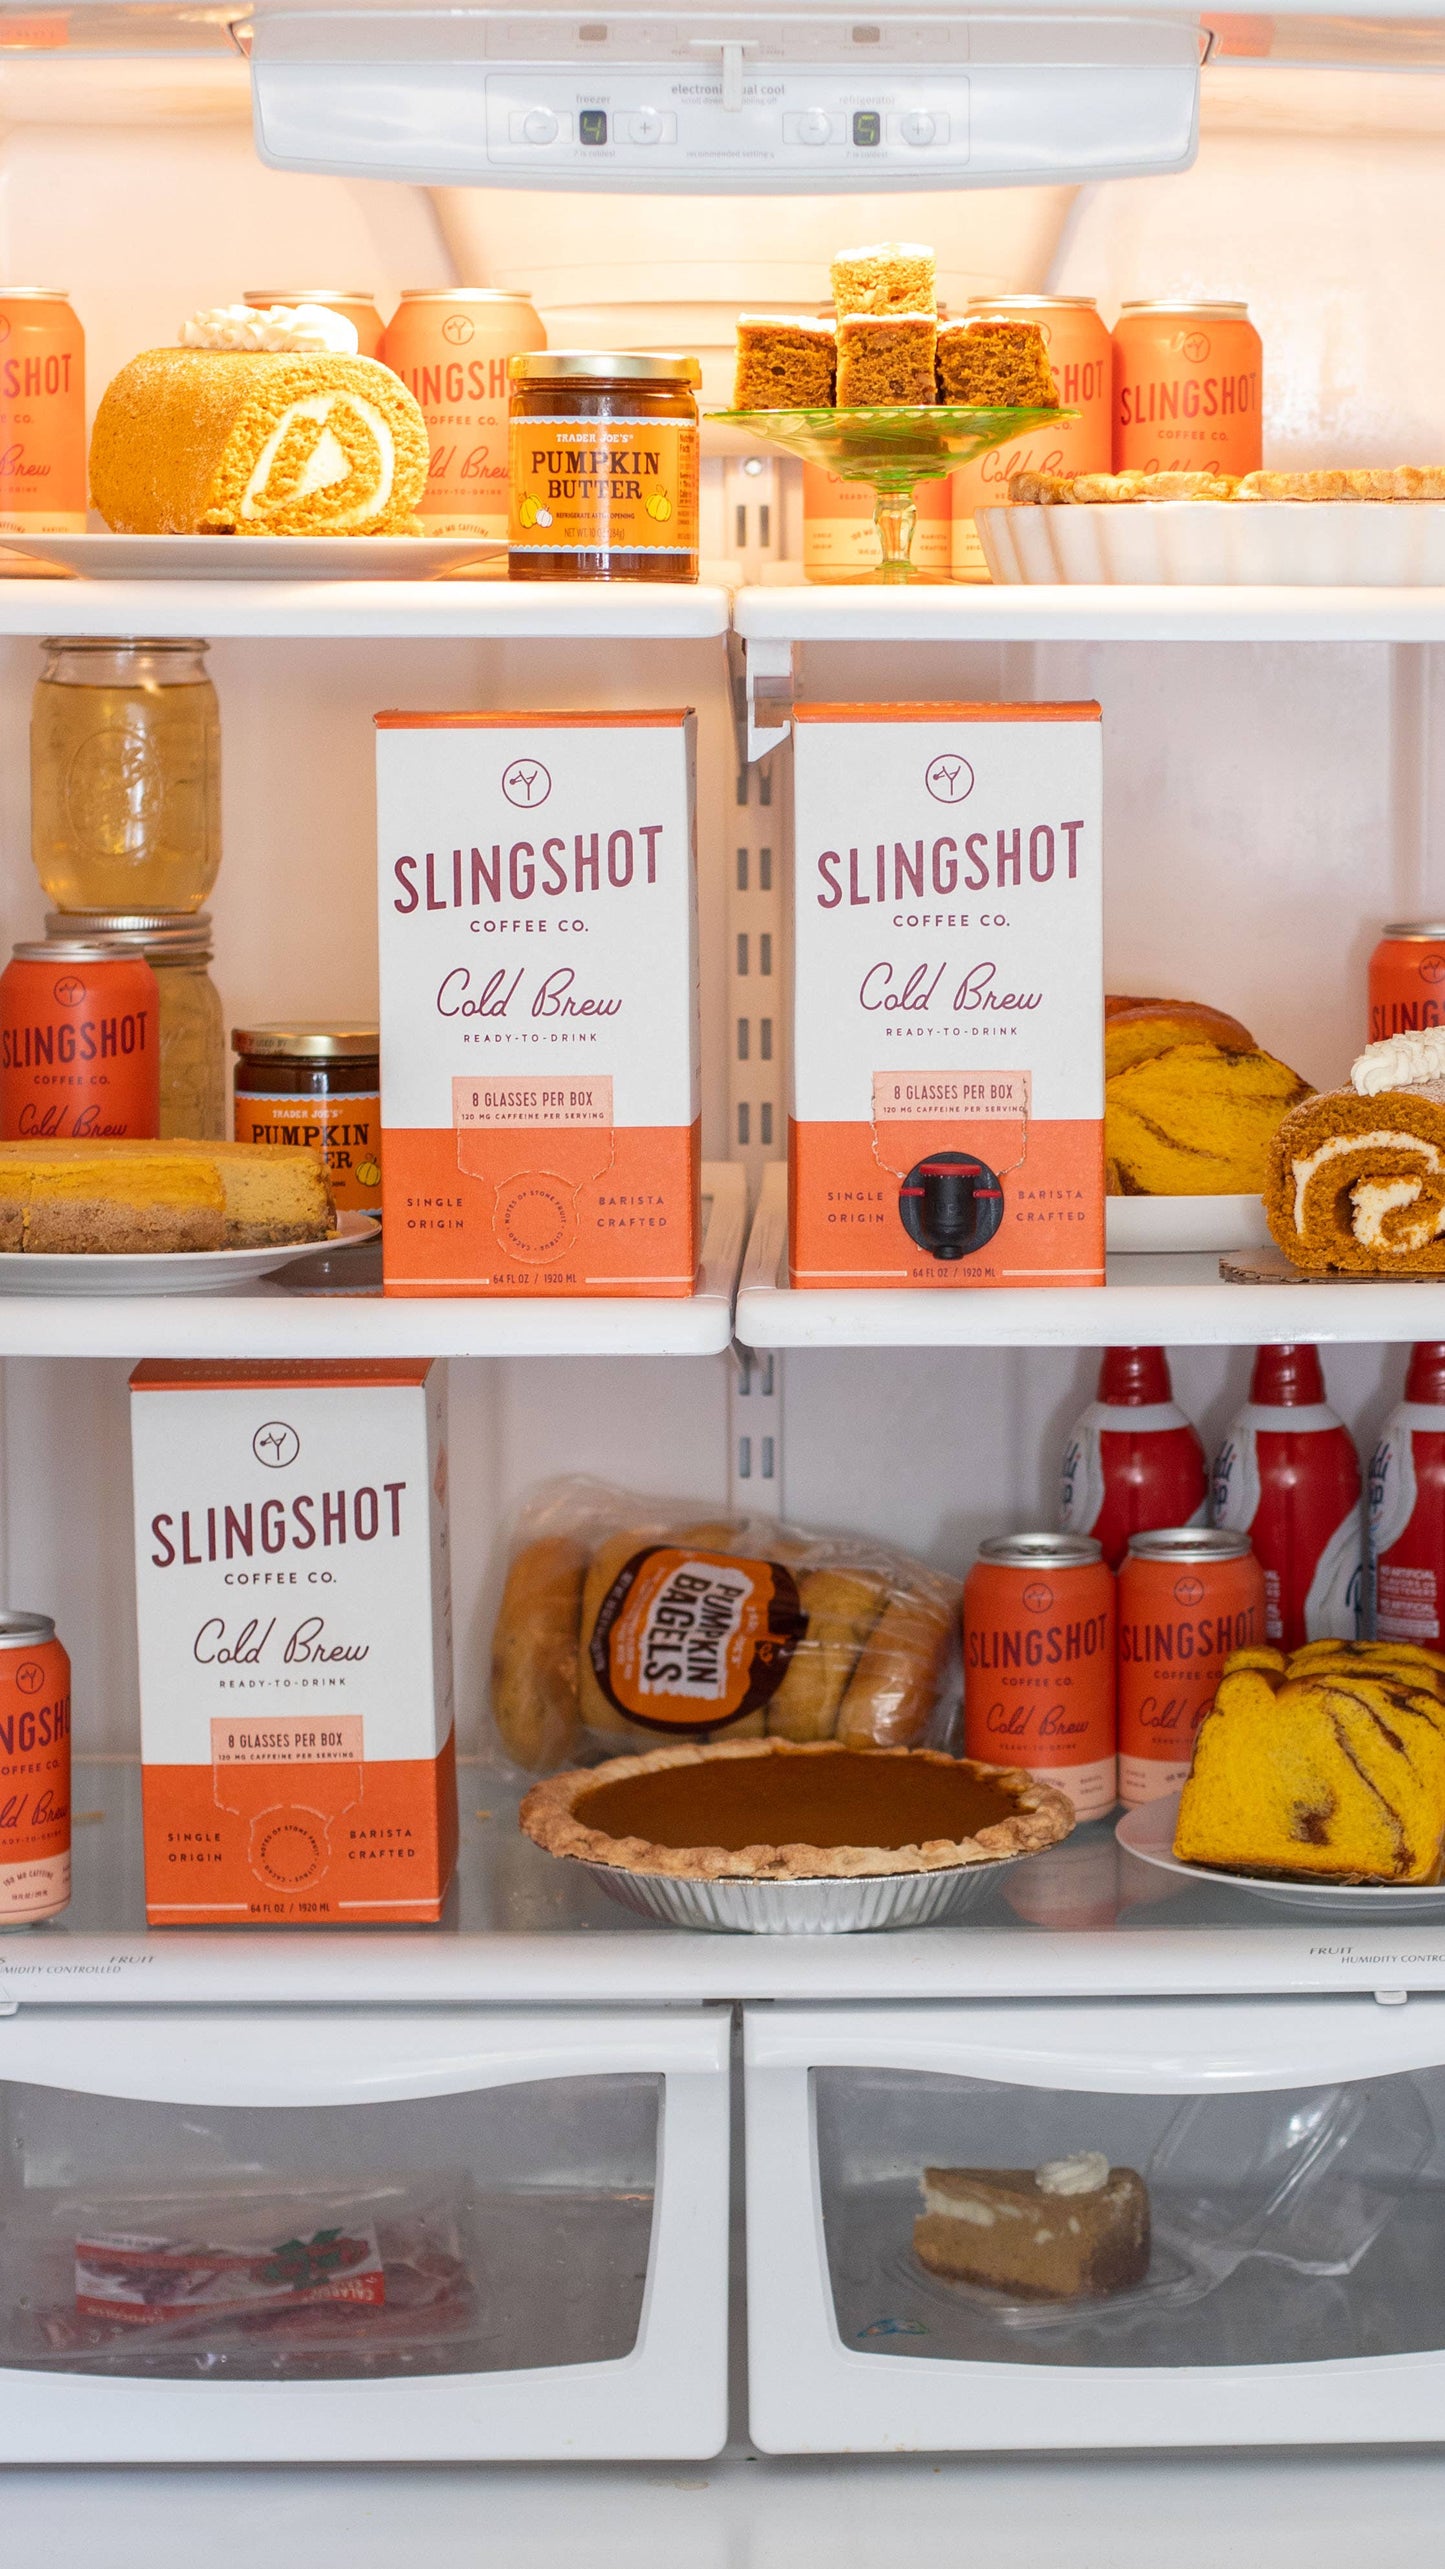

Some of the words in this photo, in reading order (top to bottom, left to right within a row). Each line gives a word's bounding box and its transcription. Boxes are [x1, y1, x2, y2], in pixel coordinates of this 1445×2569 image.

[671, 84, 723, 95] electroni
[761, 84, 785, 95] cool
[576, 94, 611, 104] freezer
[839, 95, 895, 106] refrigerator
[583, 115, 602, 142] 4
[857, 114, 876, 145] 5
[401, 358, 515, 407] INGSH
[1121, 371, 1257, 426] SLINGSHOT
[478, 416, 499, 426] CO.
[556, 434, 596, 443] TRADER
[1158, 430, 1205, 440] COFFEE
[1211, 431, 1229, 441] CO.
[428, 446, 457, 479] ld
[531, 450, 661, 475] PUMPKIN
[547, 479, 643, 499] BUTTER
[556, 511, 592, 520] REFRIGERATE
[610, 512, 636, 520] OPENING
[564, 528, 576, 538] NET
[609, 528, 625, 541] 284g)
[393, 824, 664, 914] SLINGSHOT
[816, 819, 1085, 910] SLINGSHOT
[469, 920, 547, 933] COFFEE
[557, 919, 589, 933] CO.
[892, 914, 970, 928] COFFEE
[979, 914, 1011, 927] CO.
[436, 967, 525, 1017] Cold
[531, 967, 623, 1017] Brew
[859, 961, 948, 1011] Cold
[952, 961, 1043, 1011] Brew
[1372, 999, 1445, 1042] SLING
[885, 1026, 1018, 1037] READY-TO-DRINK
[1, 1010, 149, 1069] SLINGSHOT
[463, 1033, 598, 1044] READY-TO-DRINK
[33, 1075, 83, 1086] COFFEE
[89, 1075, 111, 1086] CO.
[893, 1085, 901, 1100] 8
[906, 1084, 958, 1100] GLASSES
[963, 1084, 985, 1100] PER
[990, 1084, 1013, 1099] BOX
[472, 1092, 480, 1108] 8
[484, 1091, 538, 1108] GLASSES
[542, 1091, 565, 1107] PER
[570, 1091, 593, 1107] BOX
[271, 1109, 309, 1119] TRADER
[883, 1106, 897, 1114] 120
[18, 1102, 70, 1137] Cold
[72, 1103, 128, 1137] Brew
[461, 1113, 476, 1121] 120
[543, 1112, 561, 1120] PER
[564, 1112, 605, 1120] SERVING
[251, 1123, 370, 1147] PUMPKIN
[597, 1195, 666, 1206] BARISTA
[827, 1191, 885, 1201] SINGLE
[1017, 1189, 1084, 1200] BARISTA
[406, 1197, 464, 1208] SINGLE
[596, 1217, 668, 1228] CRAFTED
[827, 1213, 885, 1223] ORIGIN
[1015, 1211, 1087, 1222] CRAFTED
[406, 1219, 465, 1230] ORIGIN
[493, 1273, 504, 1284] 64
[506, 1273, 517, 1284] FL
[518, 1273, 530, 1284] OZ
[543, 1273, 565, 1284] 1920
[566, 1273, 577, 1284] ML
[912, 1267, 924, 1278] 64
[925, 1267, 936, 1278] FL
[937, 1267, 949, 1278] OZ
[962, 1267, 983, 1278] 1920
[984, 1267, 996, 1277] ML
[151, 1481, 407, 1569] SLINGSHOT
[224, 1572, 298, 1586] COFFEE
[307, 1571, 338, 1585] CO.
[643, 1572, 712, 1683] BAGELS
[686, 1583, 746, 1684] PUMPKIN
[193, 1616, 277, 1664] Cold
[283, 1616, 370, 1664] Brew
[1121, 1606, 1256, 1663] SLINGSHOT
[968, 1612, 1108, 1670] SLINGSHOT
[1153, 1670, 1201, 1680] COFFEE
[1206, 1670, 1224, 1680] CO
[219, 1677, 347, 1689] READY-TO-DRINK
[1001, 1676, 1050, 1687] COFFEE
[1138, 1696, 1189, 1729] Cold
[986, 1702, 1035, 1736] Cold
[1039, 1704, 1090, 1736] Brew
[228, 1733, 236, 1749] 8
[239, 1733, 291, 1749] GLASSES
[294, 1732, 318, 1748] PER
[320, 1732, 343, 1747] BOX
[250, 1753, 292, 1761] CAFFEINE
[296, 1752, 313, 1760] PER
[316, 1751, 354, 1760] SERVING
[1, 1762, 42, 1776] OFFEE
[0, 1793, 29, 1829] ld
[167, 1833, 222, 1843] SINGLE
[349, 1828, 413, 1840] BARISTA
[168, 1853, 223, 1863] ORIGIN
[348, 1848, 416, 1860] CRAFTED
[250, 1904, 262, 1914] 64
[273, 1903, 286, 1913] OZ
[298, 1902, 318, 1913] 1920
[1309, 1946, 1354, 1955] FRUIT
[109, 1955, 155, 1964] FRUIT
[1341, 1955, 1398, 1964] HUMIDITY
[1400, 1954, 1445, 1963] CONTRO
[1, 1965, 44, 1974] MIDITY
[46, 1965, 122, 1975] CONTROLLED
